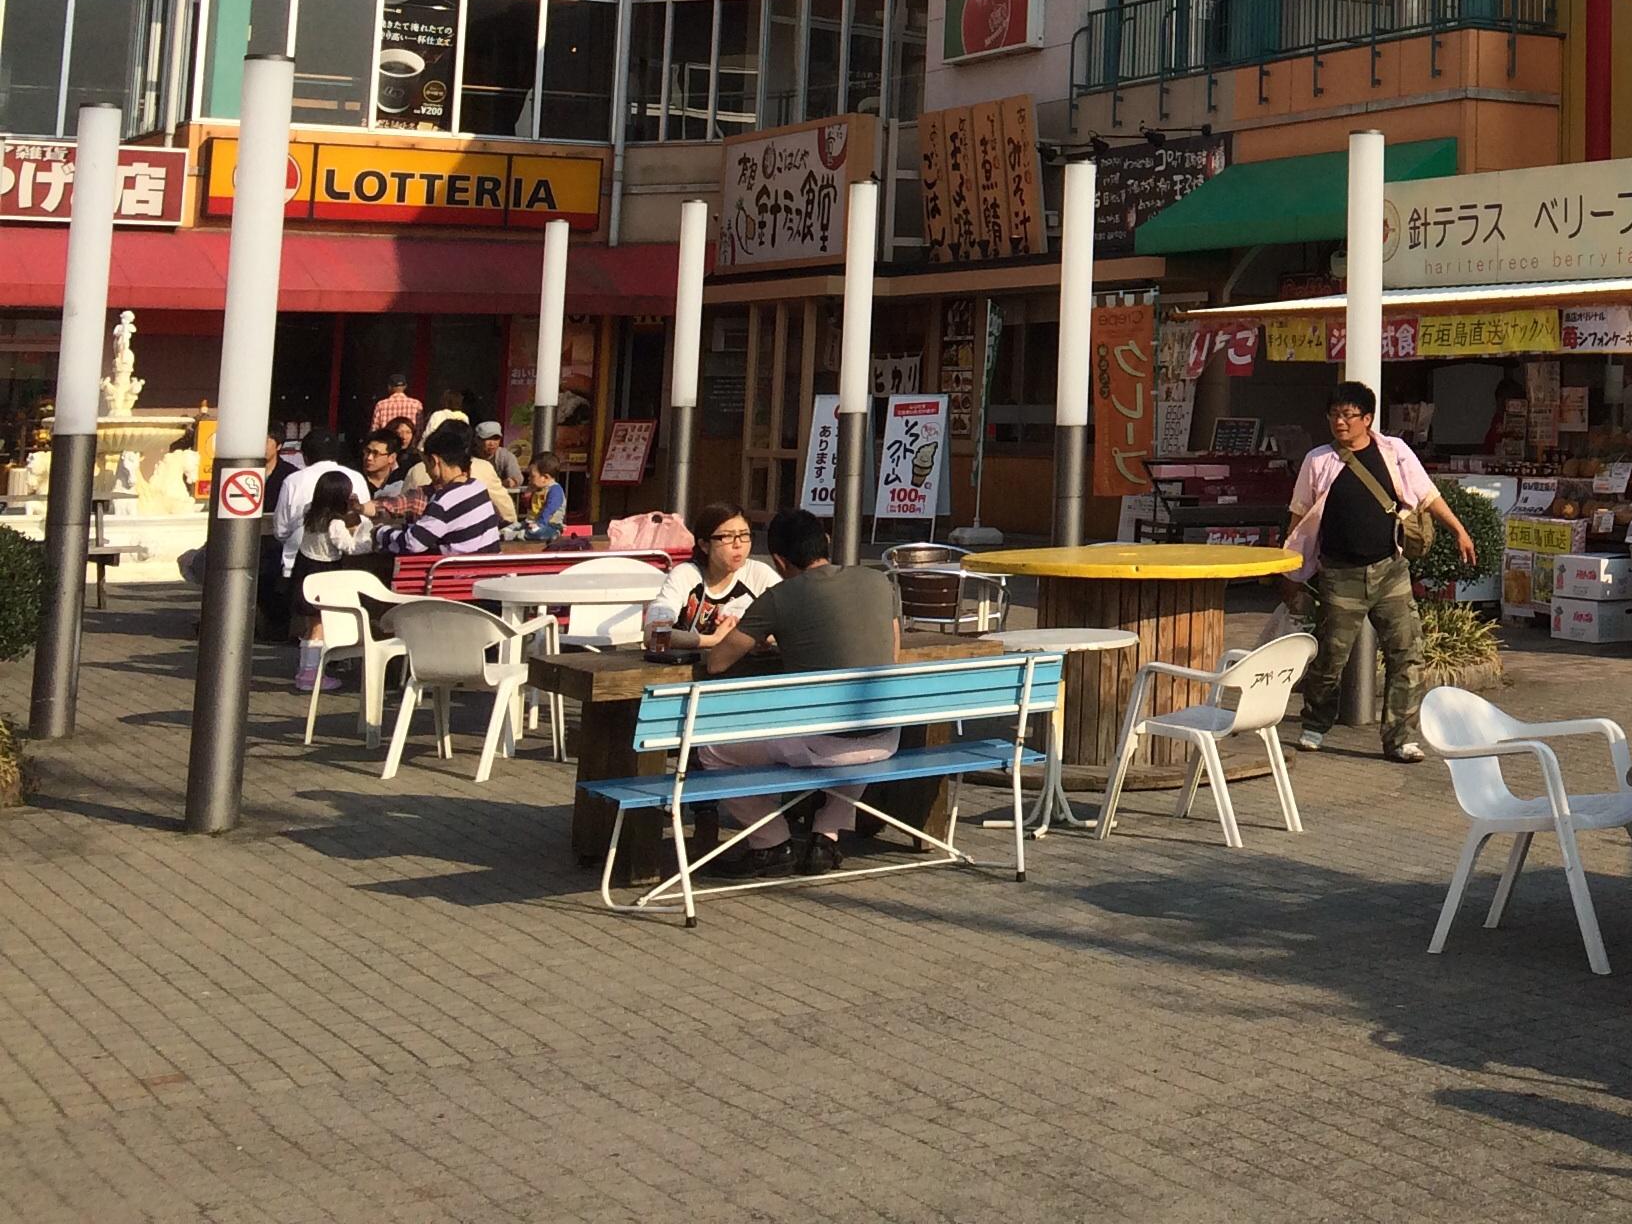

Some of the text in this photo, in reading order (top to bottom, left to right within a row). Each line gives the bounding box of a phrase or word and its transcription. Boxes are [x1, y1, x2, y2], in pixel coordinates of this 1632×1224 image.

[324, 168, 558, 210] LOTTERIA
[1408, 202, 1506, 250] 針テラス
[1552, 249, 1609, 272] berry
[889, 487, 927, 503] 100円
